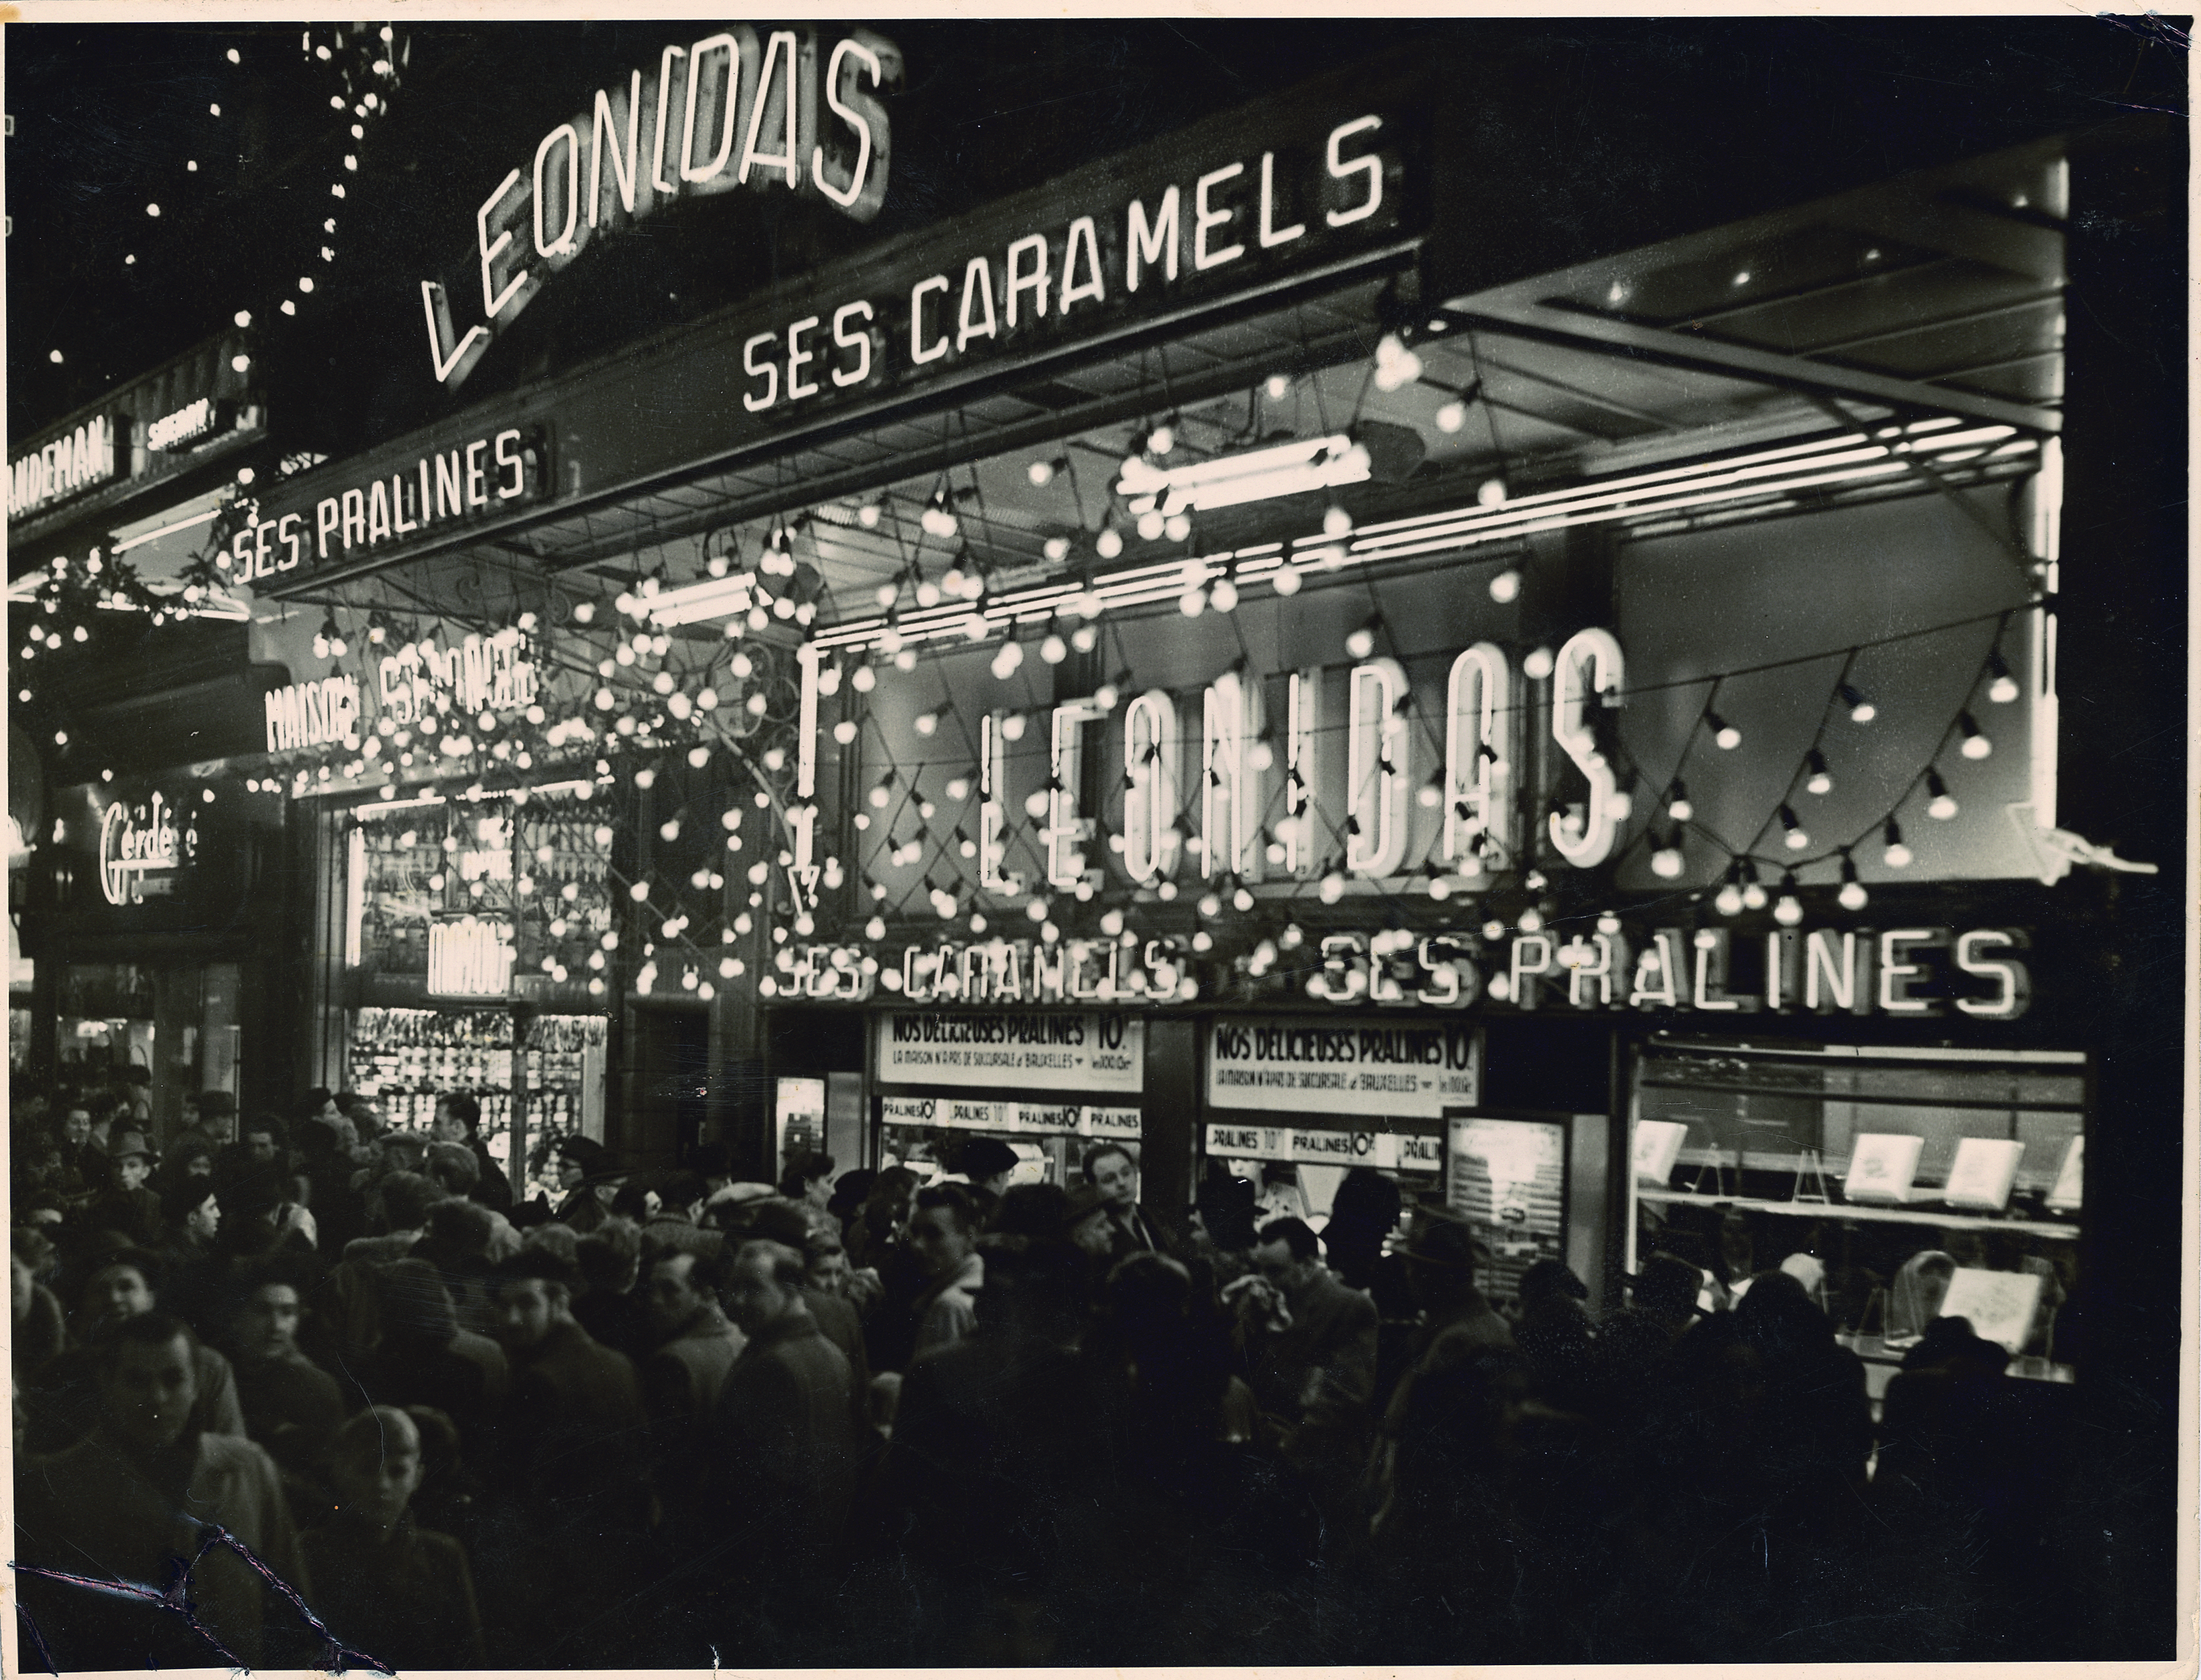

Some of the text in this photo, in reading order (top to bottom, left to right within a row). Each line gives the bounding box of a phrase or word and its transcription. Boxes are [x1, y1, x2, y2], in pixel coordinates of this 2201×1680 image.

[422, 31, 885, 383] LEONIDAS
[743, 114, 1383, 412] SES CARAMELS
[233, 429, 523, 584] SES PRALINES
[981, 629, 1619, 888] LEONIDAS
[776, 941, 1178, 1000] SES CARAMELS
[1322, 930, 2015, 1015] SES PRALINES
[893, 1014, 921, 1042] NOS
[1008, 1015, 1084, 1045] PRALINES
[1026, 1053, 1073, 1069] BRUXELLES
[1217, 1027, 1250, 1060] NOS
[1360, 1029, 1442, 1064] PRALINES
[1360, 1073, 1417, 1092] BRUXELLES
[883, 1104, 921, 1117] PRALINES
[1019, 1111, 1063, 1125] PRALINES
[1090, 1113, 1138, 1128] PRALINES
[1214, 1129, 1257, 1149] PRALINES
[1293, 1136, 1348, 1154] PRALINES
